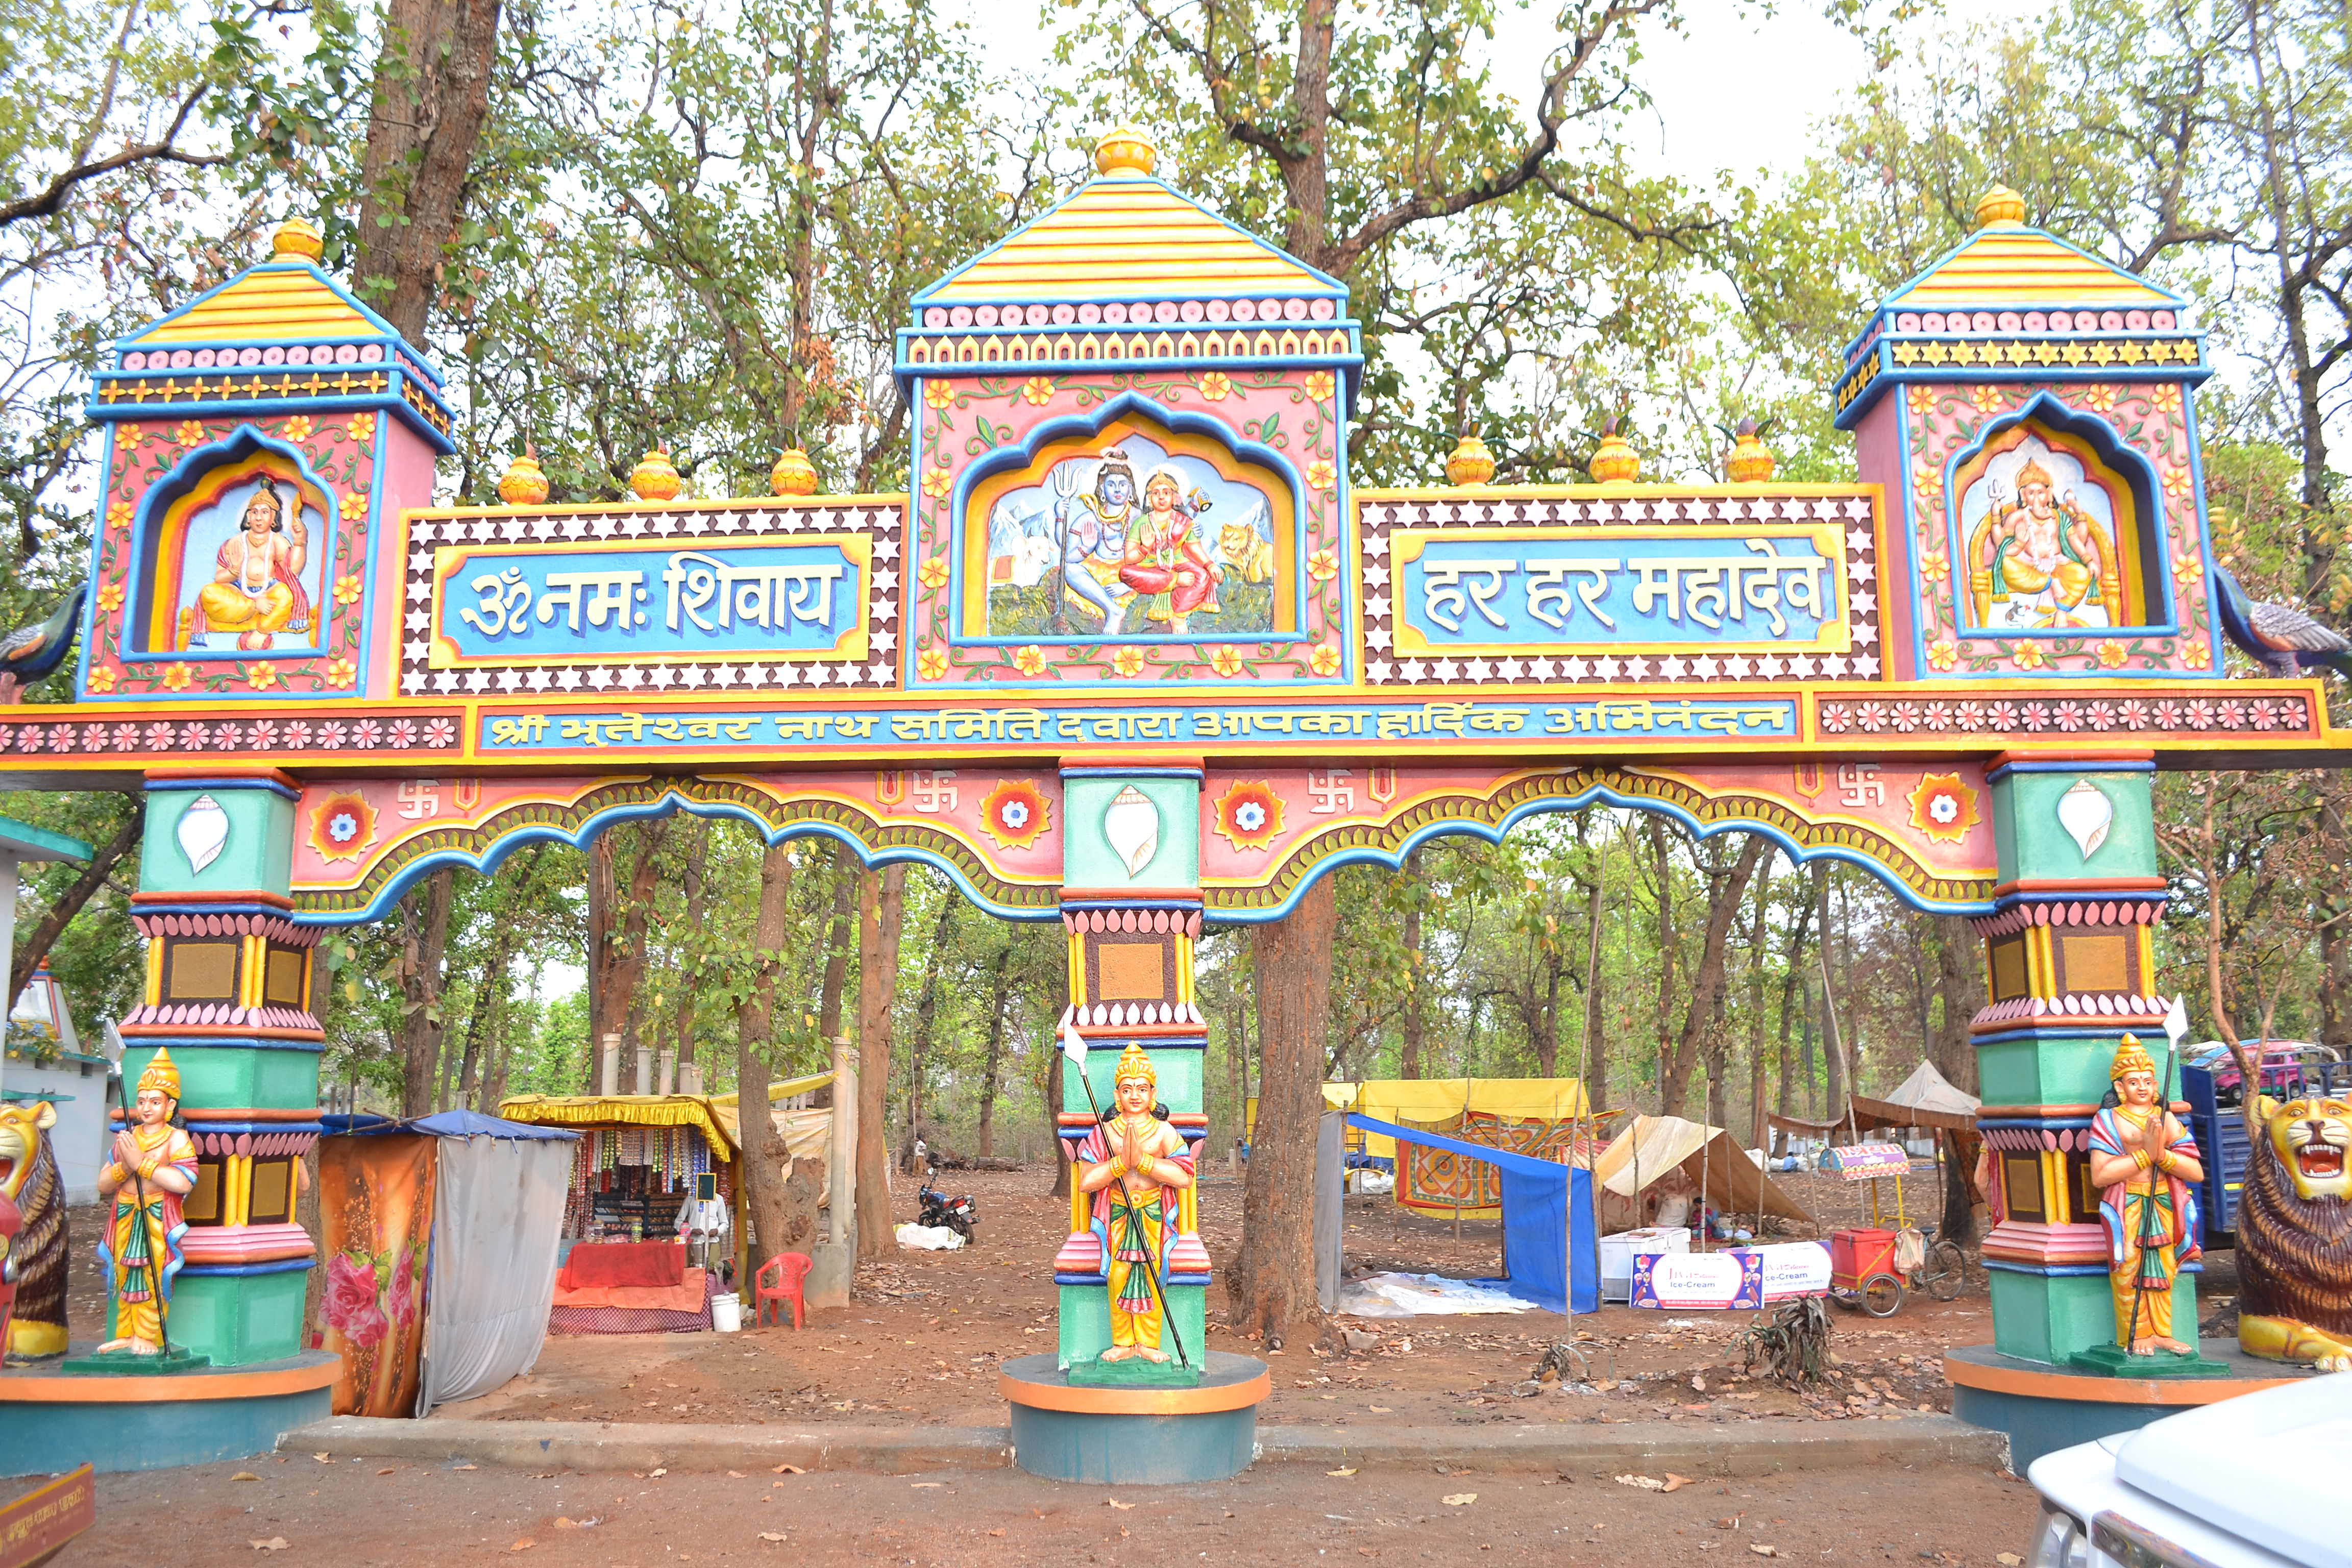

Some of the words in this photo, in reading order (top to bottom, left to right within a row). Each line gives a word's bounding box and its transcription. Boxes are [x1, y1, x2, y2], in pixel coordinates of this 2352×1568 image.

[460, 566, 531, 635] ॐ
[536, 570, 647, 630] नमः
[663, 551, 842, 630] शिवाय
[1423, 558, 1516, 632] हर
[1525, 558, 1620, 628] हर
[1627, 538, 1826, 637] महादेव
[492, 715, 550, 745] श्री
[561, 713, 762, 747] भूतेश्वर
[775, 716, 879, 739] नाथ
[891, 708, 1049, 739] समिति
[1192, 710, 1372, 736] आपका
[1377, 702, 1530, 740] हार्दिक
[1546, 700, 1790, 735] अभिनंदन
[1765, 1272, 1808, 1281] ce-Cream
